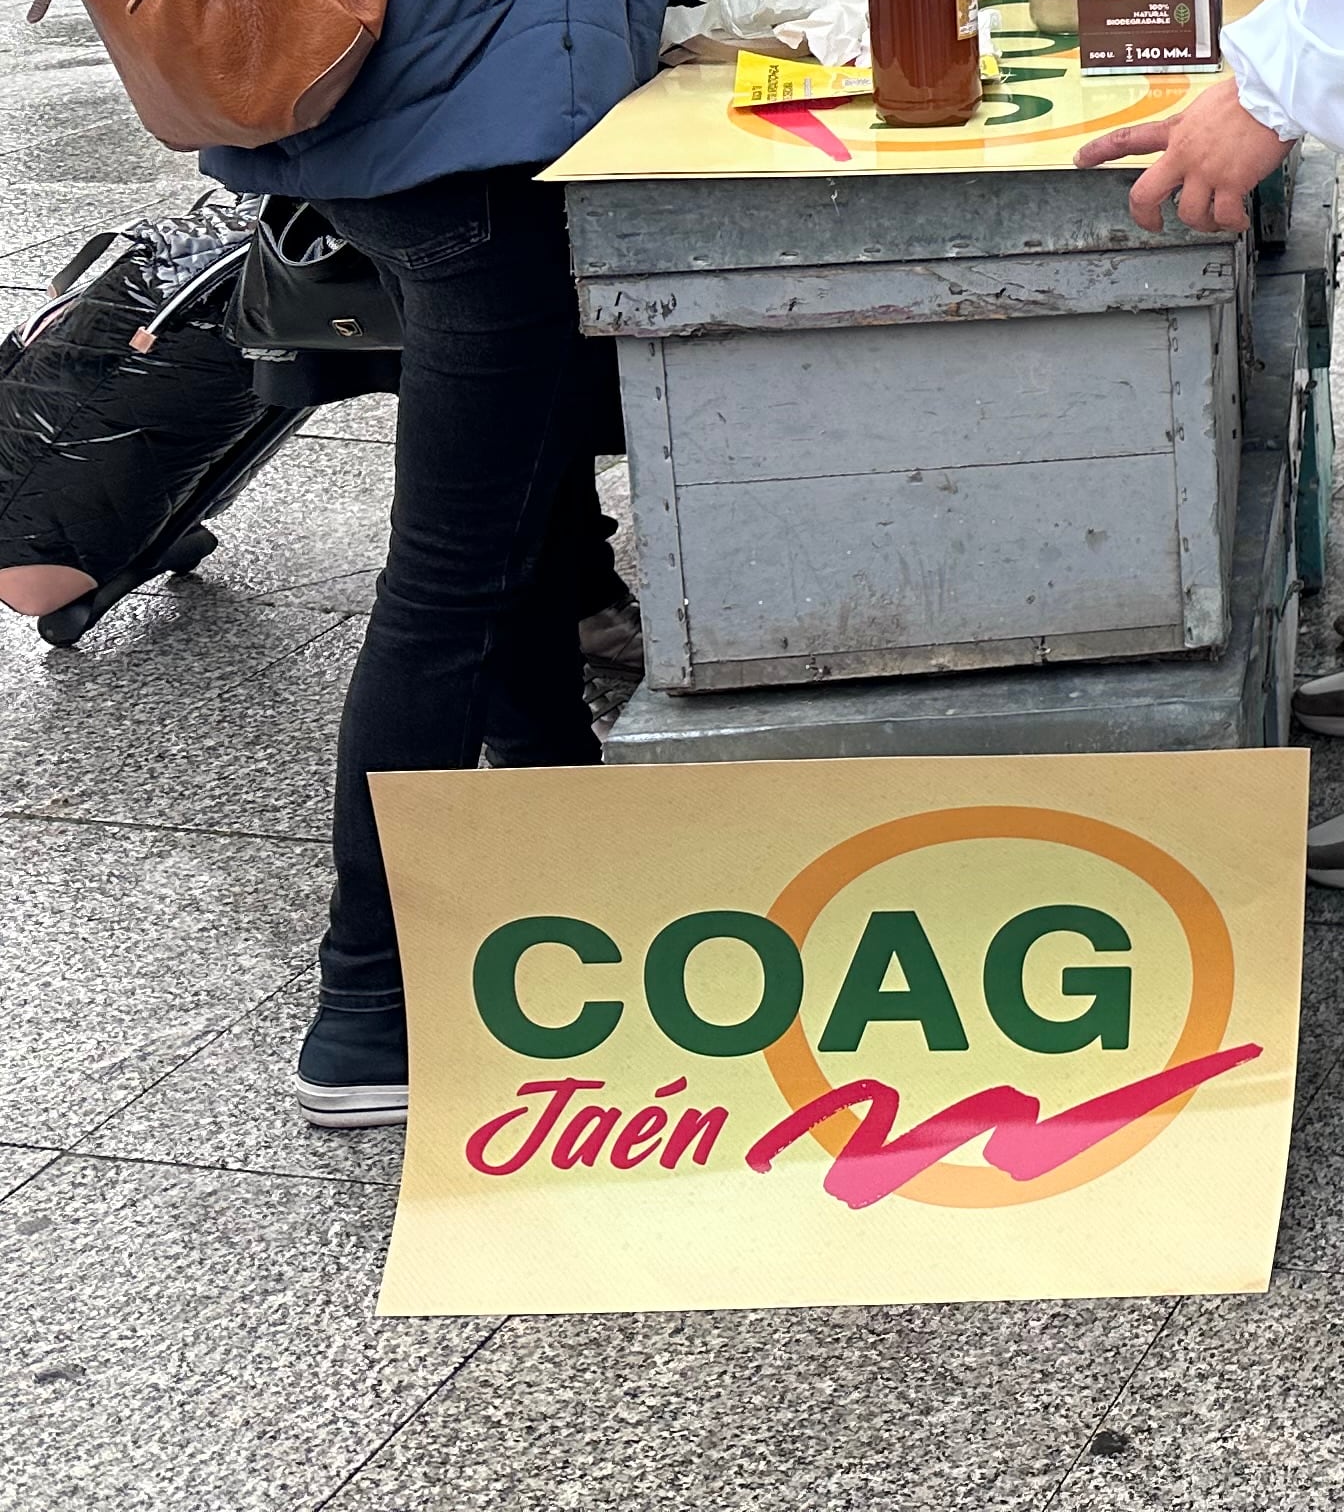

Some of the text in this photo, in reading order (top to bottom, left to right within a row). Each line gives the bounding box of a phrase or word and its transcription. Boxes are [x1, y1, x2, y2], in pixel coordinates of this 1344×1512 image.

[1106, 18, 1171, 26] BIODEGRADABLE
[1136, 47, 1192, 59] 140 MM.
[472, 904, 1133, 1060] COAG
[465, 1076, 730, 1176] Jaén
